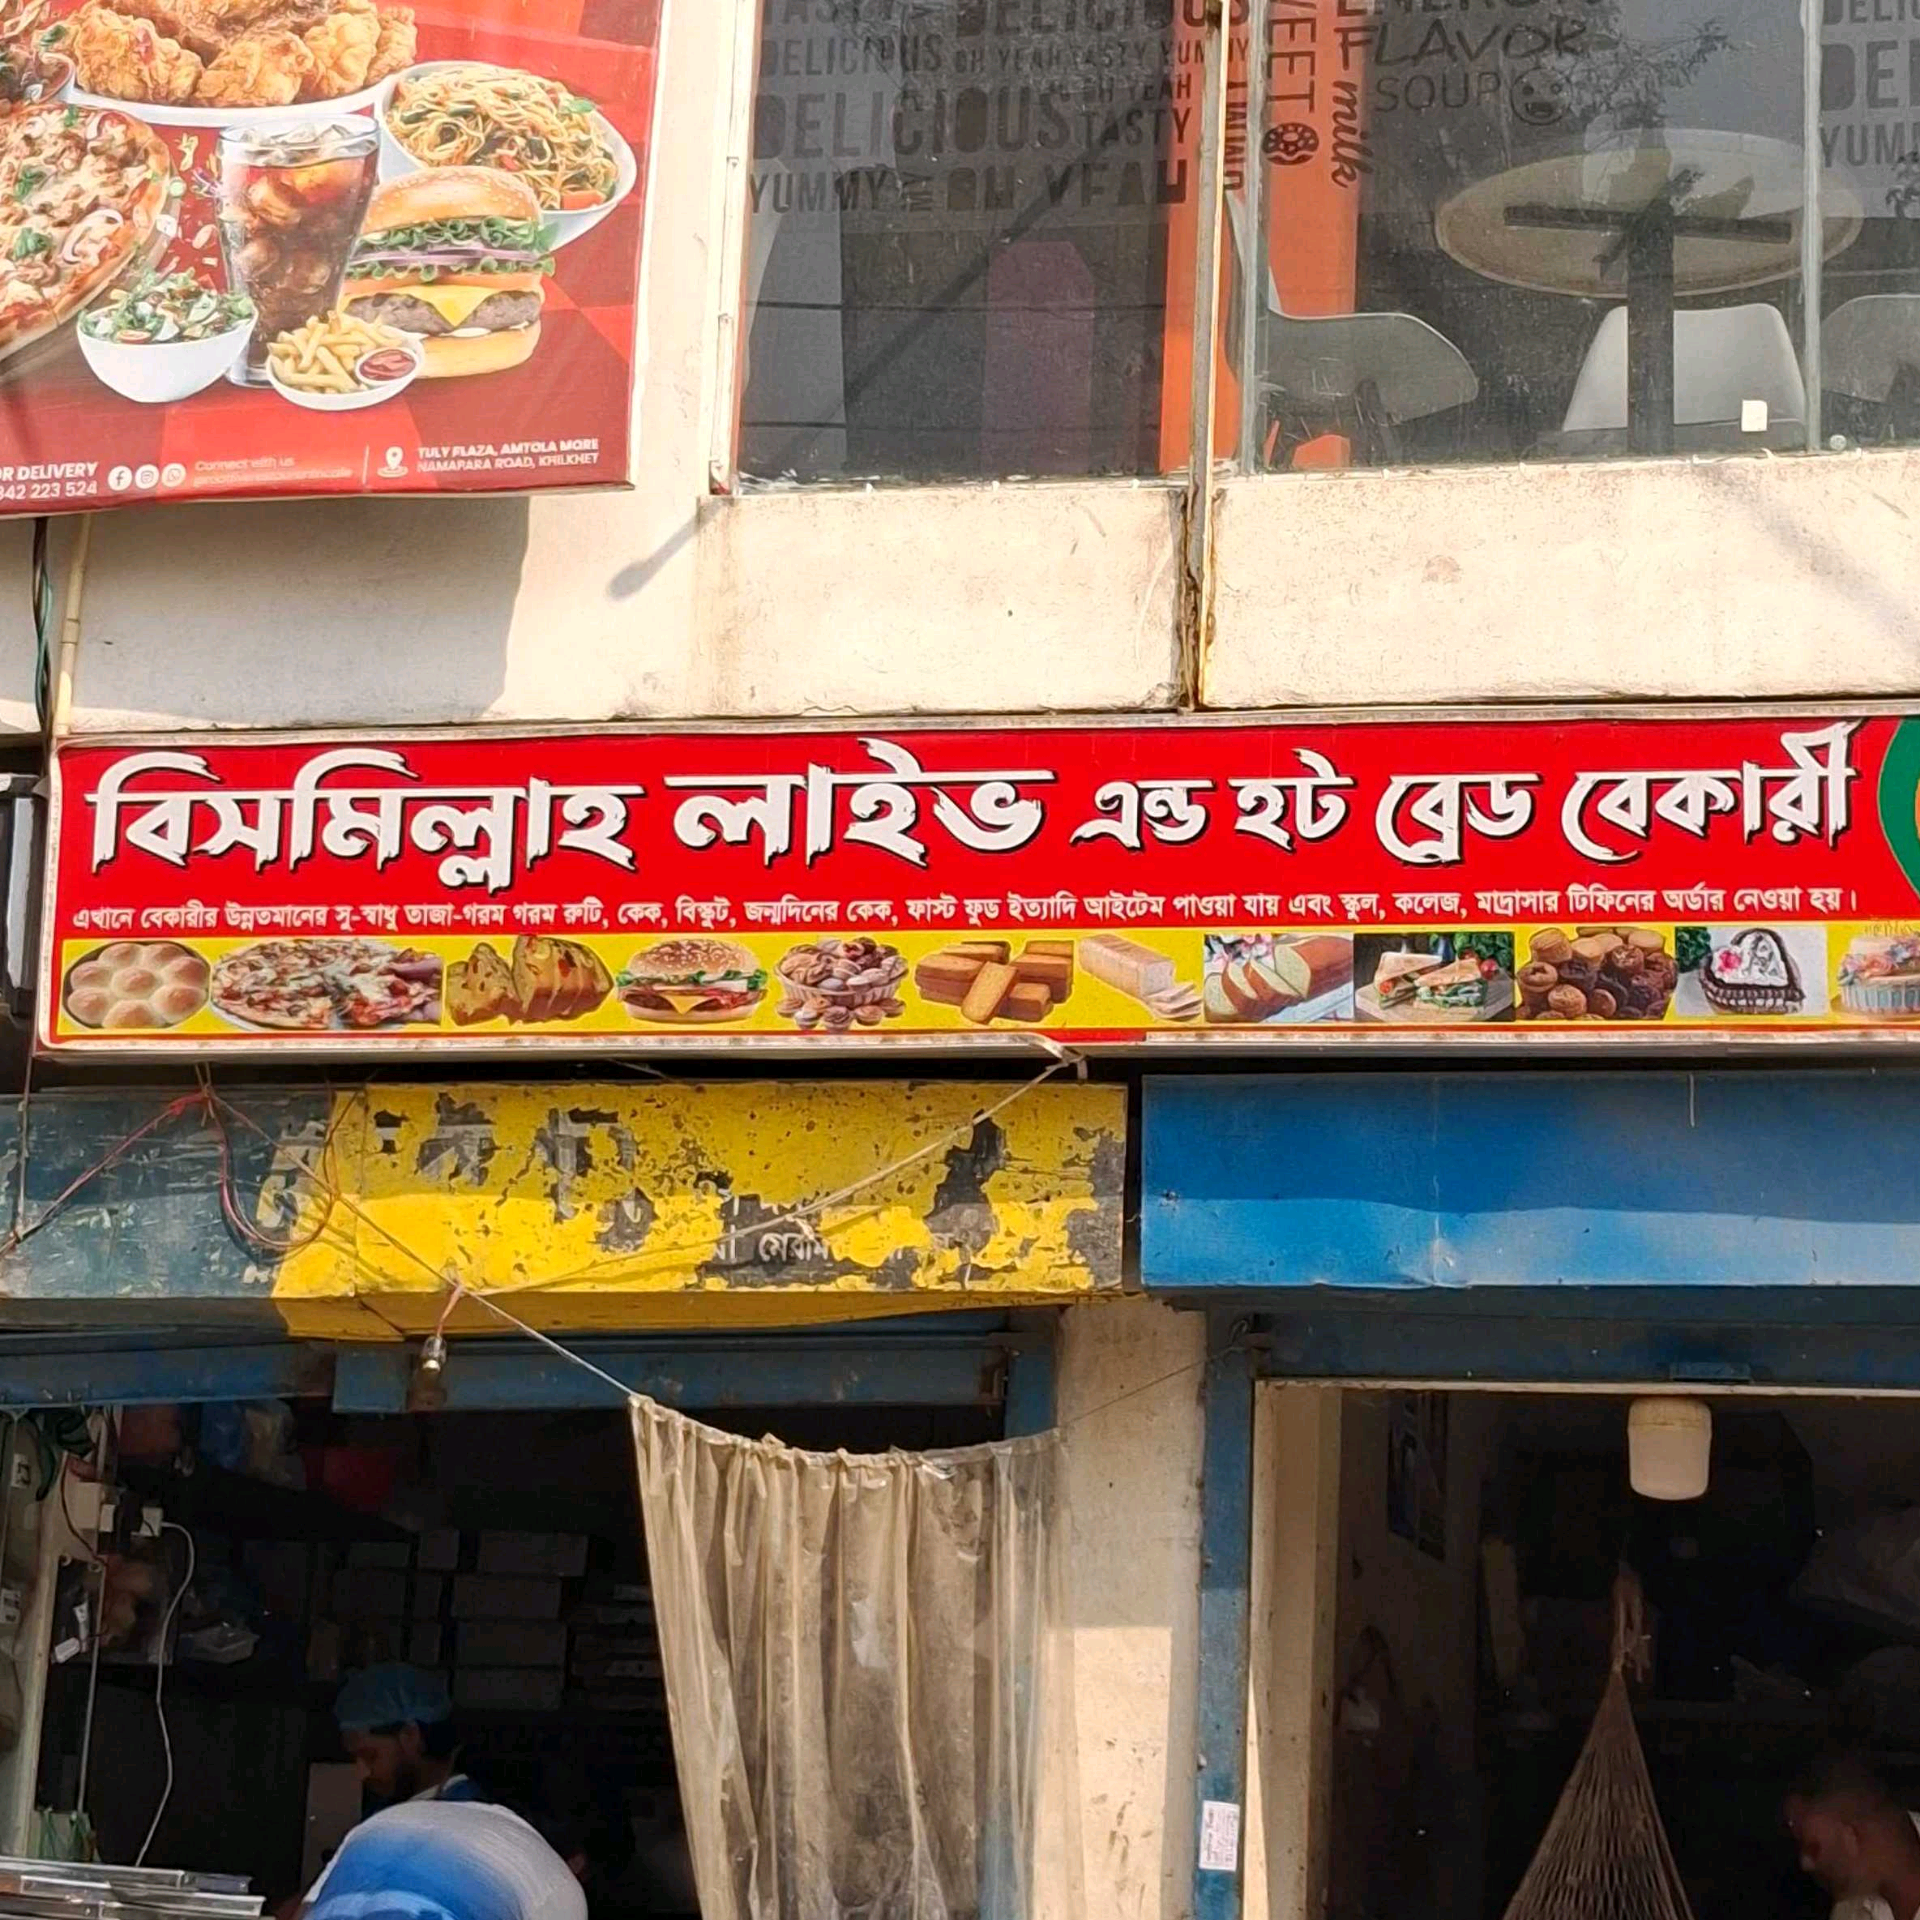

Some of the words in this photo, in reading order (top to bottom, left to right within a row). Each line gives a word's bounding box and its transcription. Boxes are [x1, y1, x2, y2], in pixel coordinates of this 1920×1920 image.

[1374, 71, 1501, 112] SOUP
[753, 86, 1071, 161] DELICIOUS
[1083, 106, 1192, 148] TASTY
[1331, 80, 1374, 189] milk
[750, 170, 888, 214] YUMMY
[17, 461, 98, 481] DELIVERY
[418, 446, 449, 459] TULY
[500, 440, 557, 455] AMTOLA
[30, 482, 60, 499] 223
[65, 480, 98, 497] 524
[85, 747, 647, 895] বিসমিল্লাহ
[663, 737, 1057, 868] লাইভ
[1070, 778, 1215, 850] এন্ড
[1228, 748, 1355, 853] হট
[1375, 772, 1542, 867] ব্রেড
[1561, 717, 1862, 866] বেকারী
[73, 907, 135, 930] এখানে
[141, 899, 219, 929] বেকারীর
[224, 901, 330, 932] উন্নতমানের
[513, 902, 558, 925] গরম
[563, 896, 609, 928] রুটি,
[618, 902, 668, 928] কেক,
[744, 894, 840, 925] জন্মদিনের
[846, 899, 899, 926] কেক,
[905, 893, 959, 923] ফাস্ট
[964, 899, 1002, 927] ফুড
[1007, 890, 1078, 922] ইত্যাদি
[1083, 890, 1166, 921] আইটেম
[1173, 893, 1238, 919] পাওয়া
[1242, 894, 1281, 918] যায়
[1289, 893, 1334, 918] এবং
[1338, 893, 1387, 923] স্কুল,
[1392, 892, 1467, 919] কলেজ,
[1474, 889, 1561, 917] মাদ্রাসার
[1565, 883, 1657, 913] টিফিনের
[1662, 882, 1727, 912] অর্ডার
[1733, 886, 1802, 912] নেওয়া
